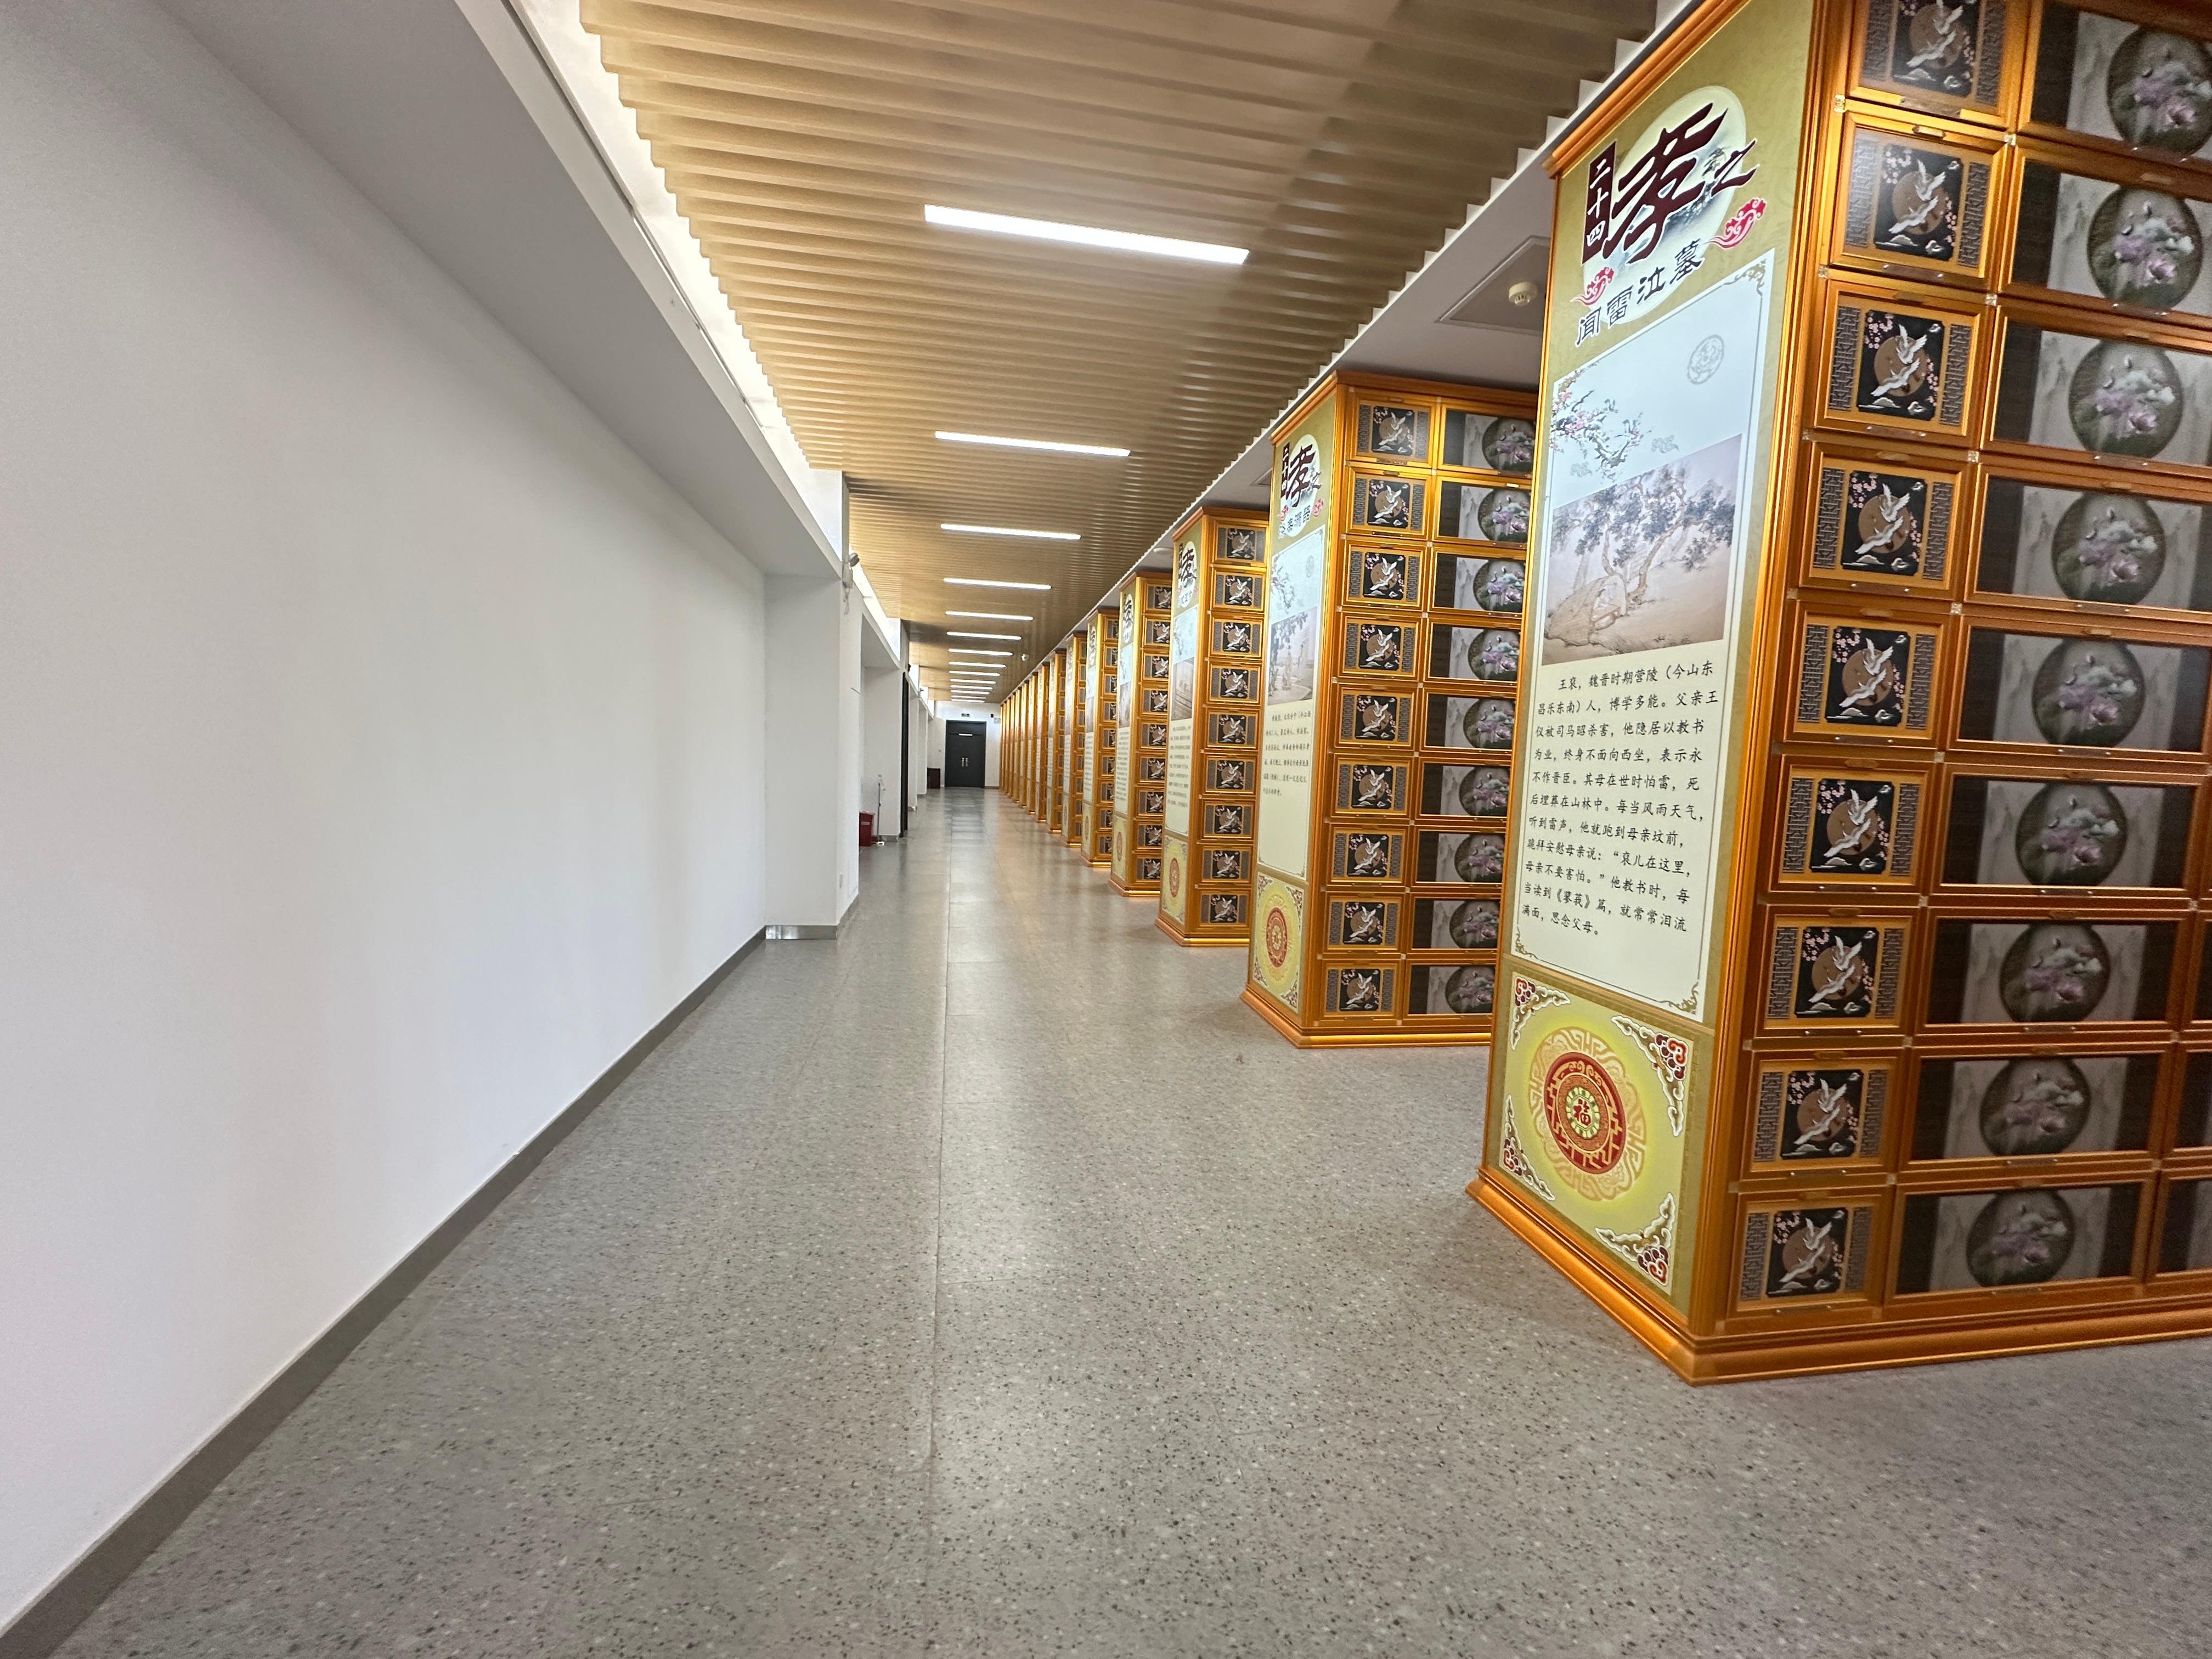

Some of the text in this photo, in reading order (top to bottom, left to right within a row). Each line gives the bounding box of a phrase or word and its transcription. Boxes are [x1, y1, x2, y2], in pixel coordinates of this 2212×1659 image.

[1587, 157, 1612, 248] 二十四
[1575, 237, 1705, 347] 闻雷泣墓
[1535, 718, 1705, 738] 仪被司马昭杀害，他隐居以教书
[1534, 747, 1703, 763] 为业，终身不面向西坐，表示永
[1532, 771, 1700, 792] 不作晋臣。其母在世时怕雷，死
[1528, 816, 1684, 849] 听到雷声，他就跑到母亲坟前，
[1522, 904, 1600, 936] 满面，思念父母。
[1573, 1099, 1591, 1126] 福
